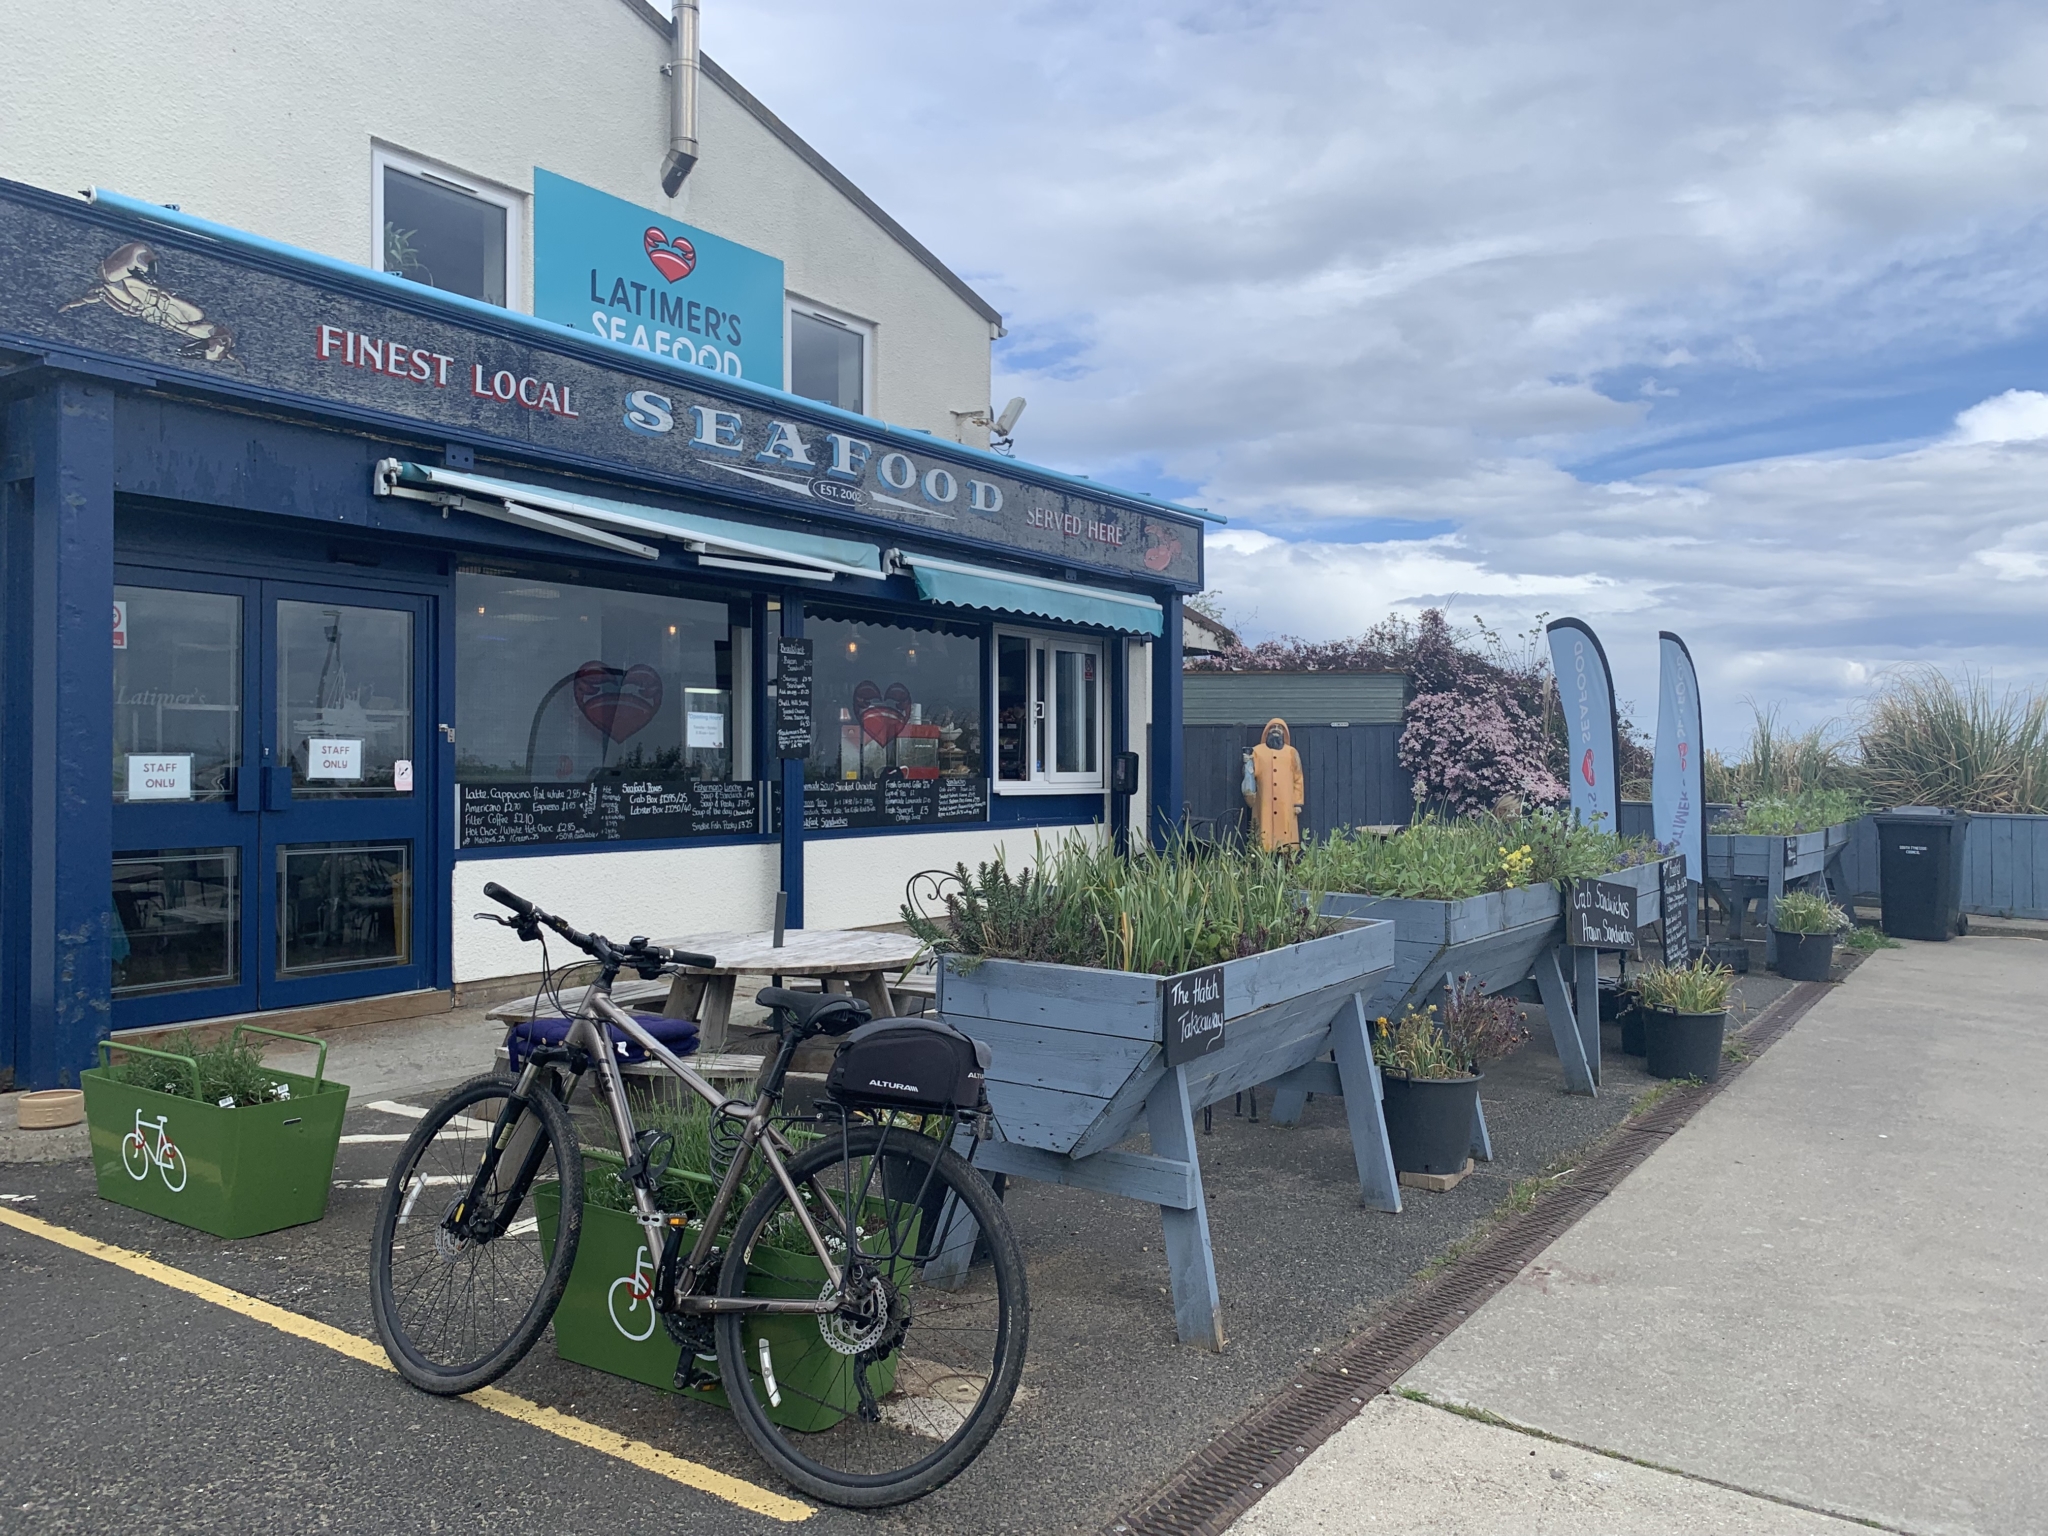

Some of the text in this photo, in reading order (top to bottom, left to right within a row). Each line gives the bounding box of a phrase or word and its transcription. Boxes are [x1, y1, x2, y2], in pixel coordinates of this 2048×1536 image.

[591, 268, 742, 347] LATIMER'S
[317, 324, 1123, 546] FINEST LOCAL SEAFOOD SERVED HERE
[820, 484, 839, 497] EST.
[117, 686, 206, 706] Latimer's
[321, 745, 350, 755] STAFF
[143, 763, 177, 773] STAFF
[323, 760, 348, 769] ONLY
[145, 778, 175, 788] ONLY
[646, 794, 658, 804] Box
[465, 803, 501, 813] Americano
[652, 805, 664, 814] Box
[465, 813, 485, 825] Filter
[488, 813, 509, 826] Coffee
[465, 827, 479, 836] Hot
[480, 826, 499, 836] Choc
[525, 824, 537, 834] Hot
[537, 823, 553, 832] Choc
[1582, 912, 1602, 942] Prawn
[1603, 918, 1635, 946] Sandwiches
[1171, 973, 1220, 1006] The Hatch
[1178, 1009, 1223, 1052] Takeaway
[869, 1079, 913, 1092] ALTURA
